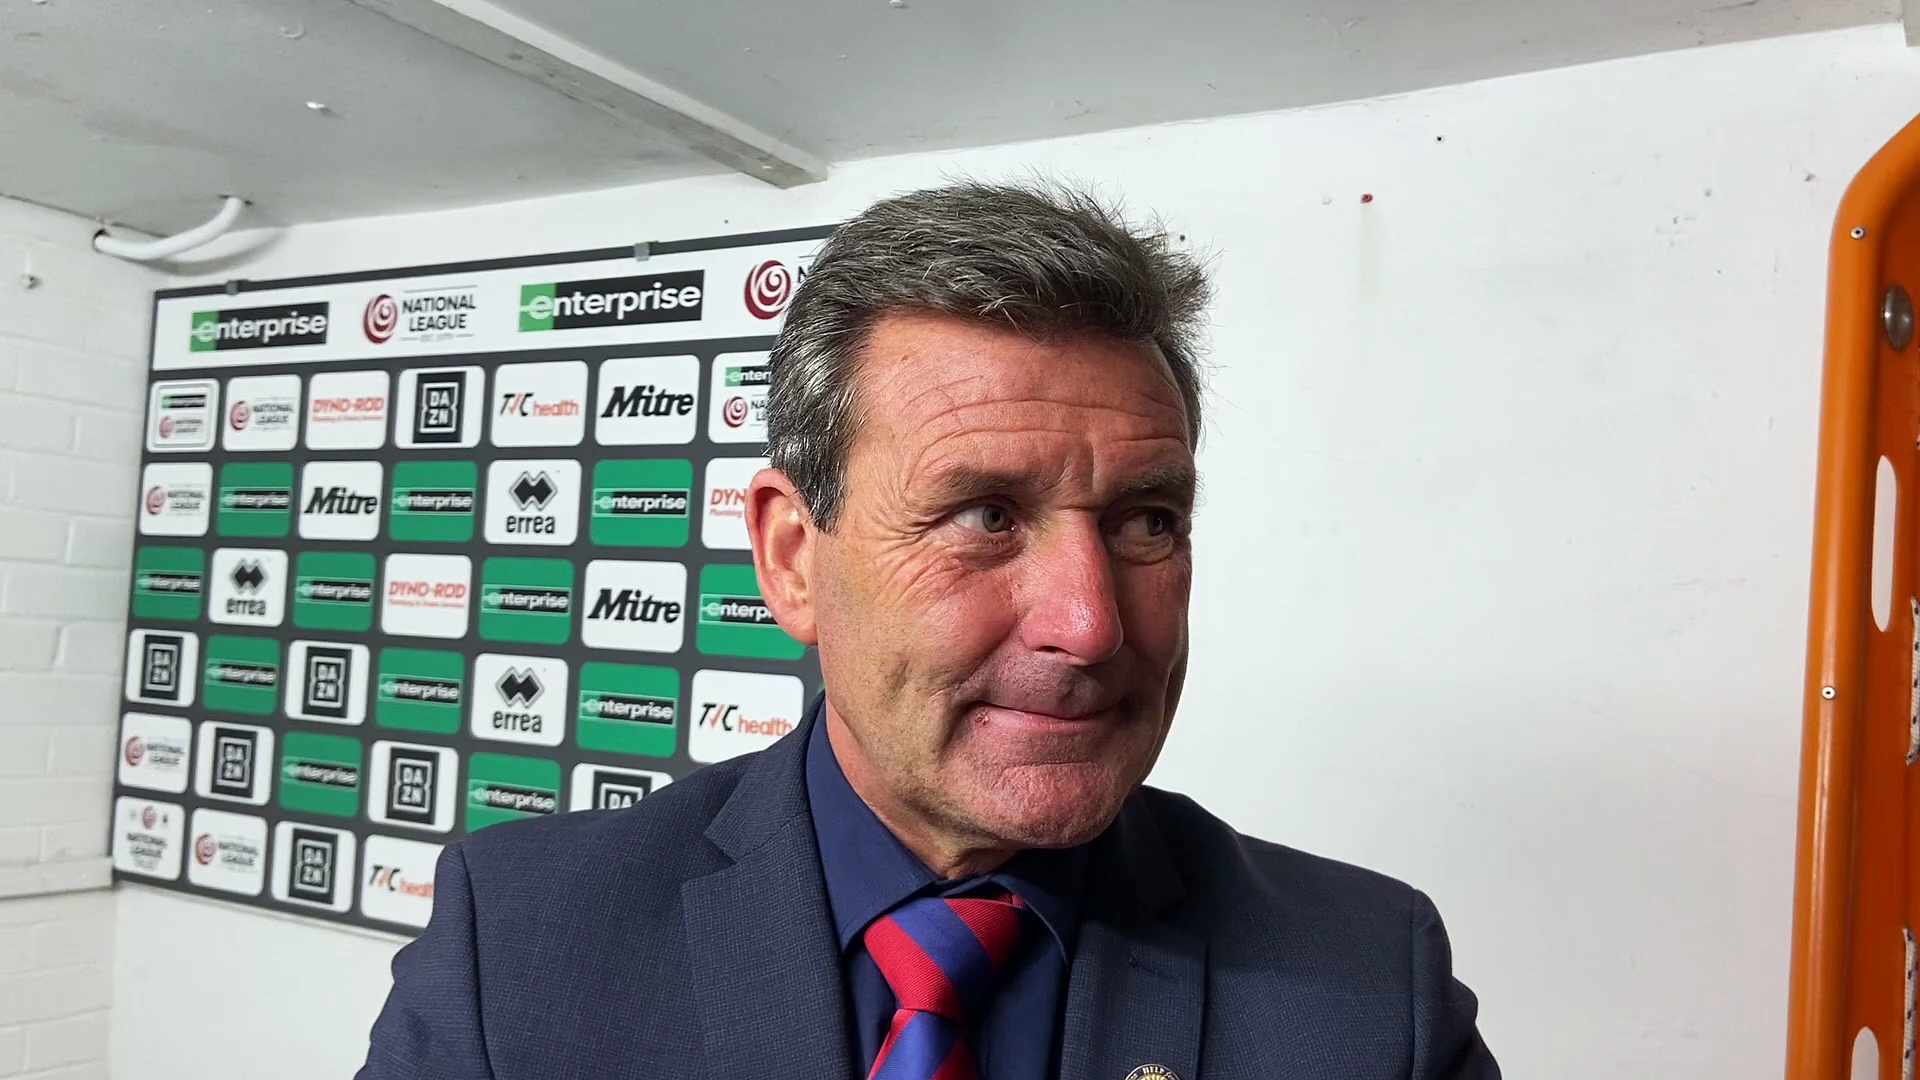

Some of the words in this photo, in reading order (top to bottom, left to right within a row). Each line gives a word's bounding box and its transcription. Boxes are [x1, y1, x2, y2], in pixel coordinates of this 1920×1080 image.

[402, 294, 476, 314] NATIONAL
[521, 281, 701, 320] enterprise
[193, 311, 327, 344] enterprise
[409, 313, 467, 332] LEAGUE
[533, 399, 579, 417] health
[601, 384, 694, 418] Mitre
[221, 493, 289, 509] enterprise
[304, 487, 378, 515] Mitre
[394, 492, 472, 510] enterprise
[594, 493, 687, 513] enterprise
[711, 488, 747, 506] DYN
[138, 574, 200, 592] enterprise
[298, 581, 372, 600] enterprise
[389, 581, 467, 598] DYNO-ROD
[483, 588, 569, 611] enterprise
[588, 588, 681, 623] Mitre
[380, 680, 460, 700] enterprise
[582, 697, 674, 720] enterprise
[284, 763, 358, 784] enterprise
[472, 786, 555, 811] enterprise
